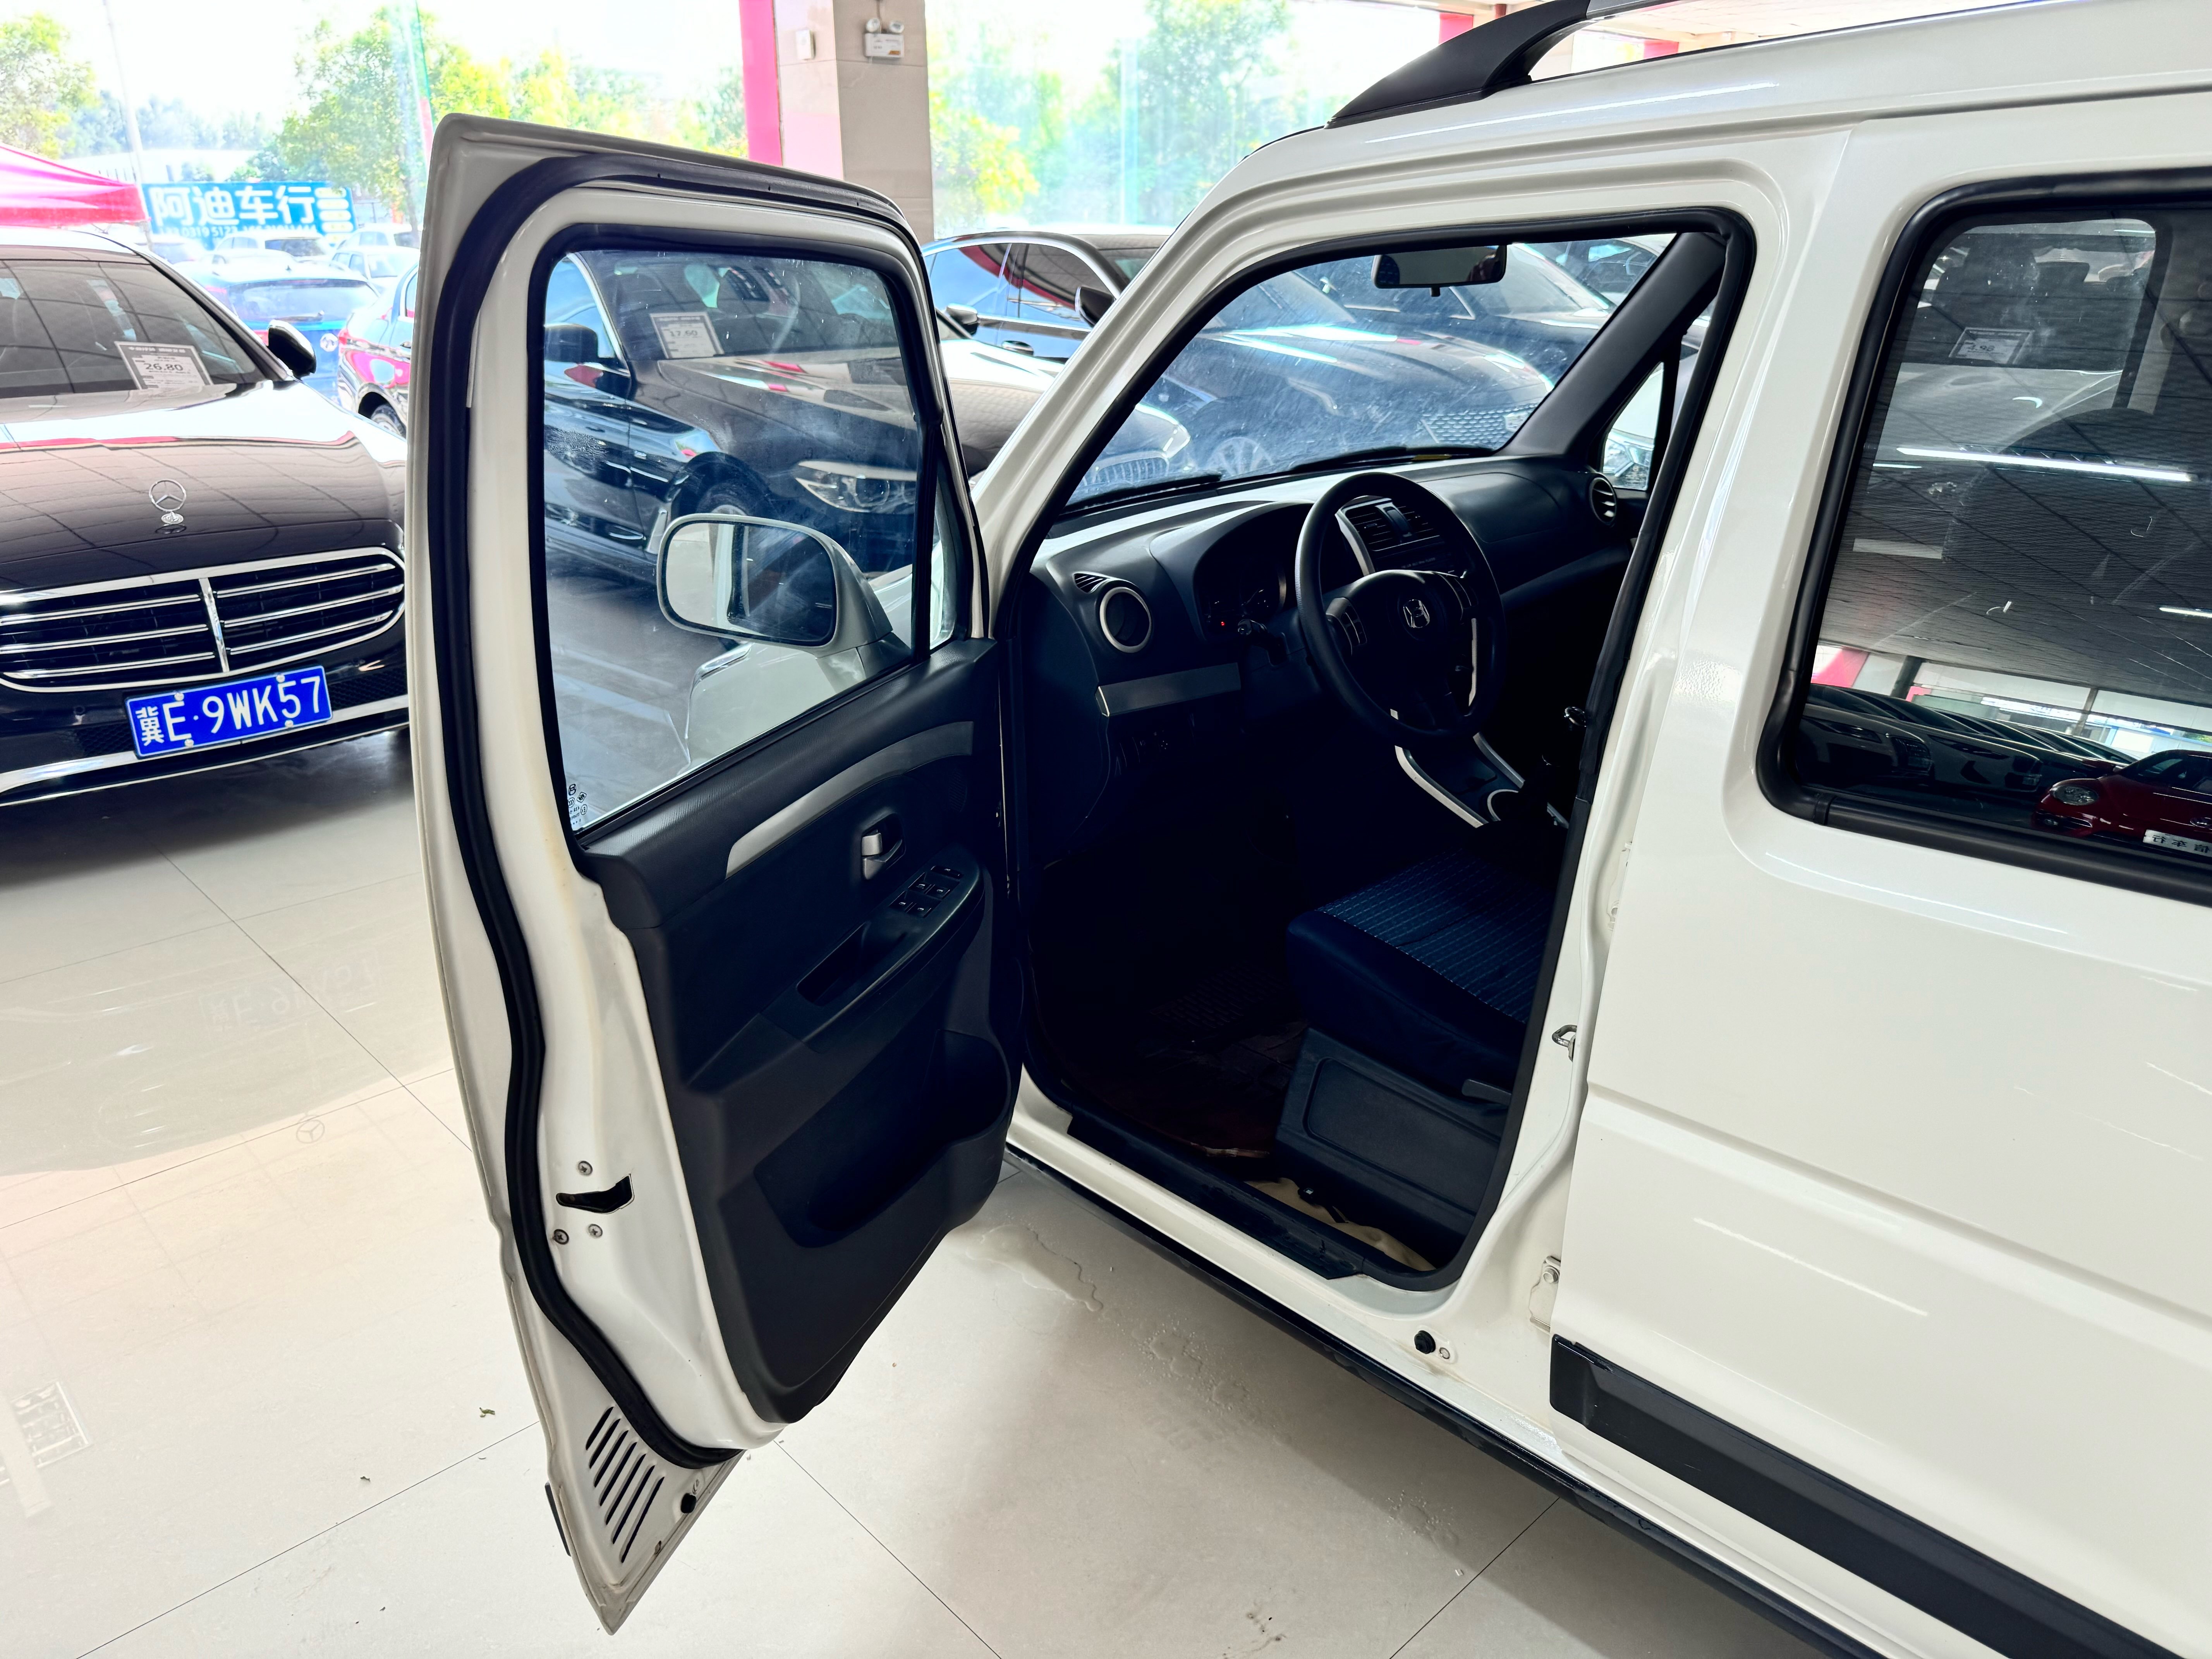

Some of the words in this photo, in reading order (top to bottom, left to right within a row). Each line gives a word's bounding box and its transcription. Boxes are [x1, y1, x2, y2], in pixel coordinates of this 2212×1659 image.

[149, 185, 315, 227] 阿迪车行
[144, 363, 184, 371] 26.80
